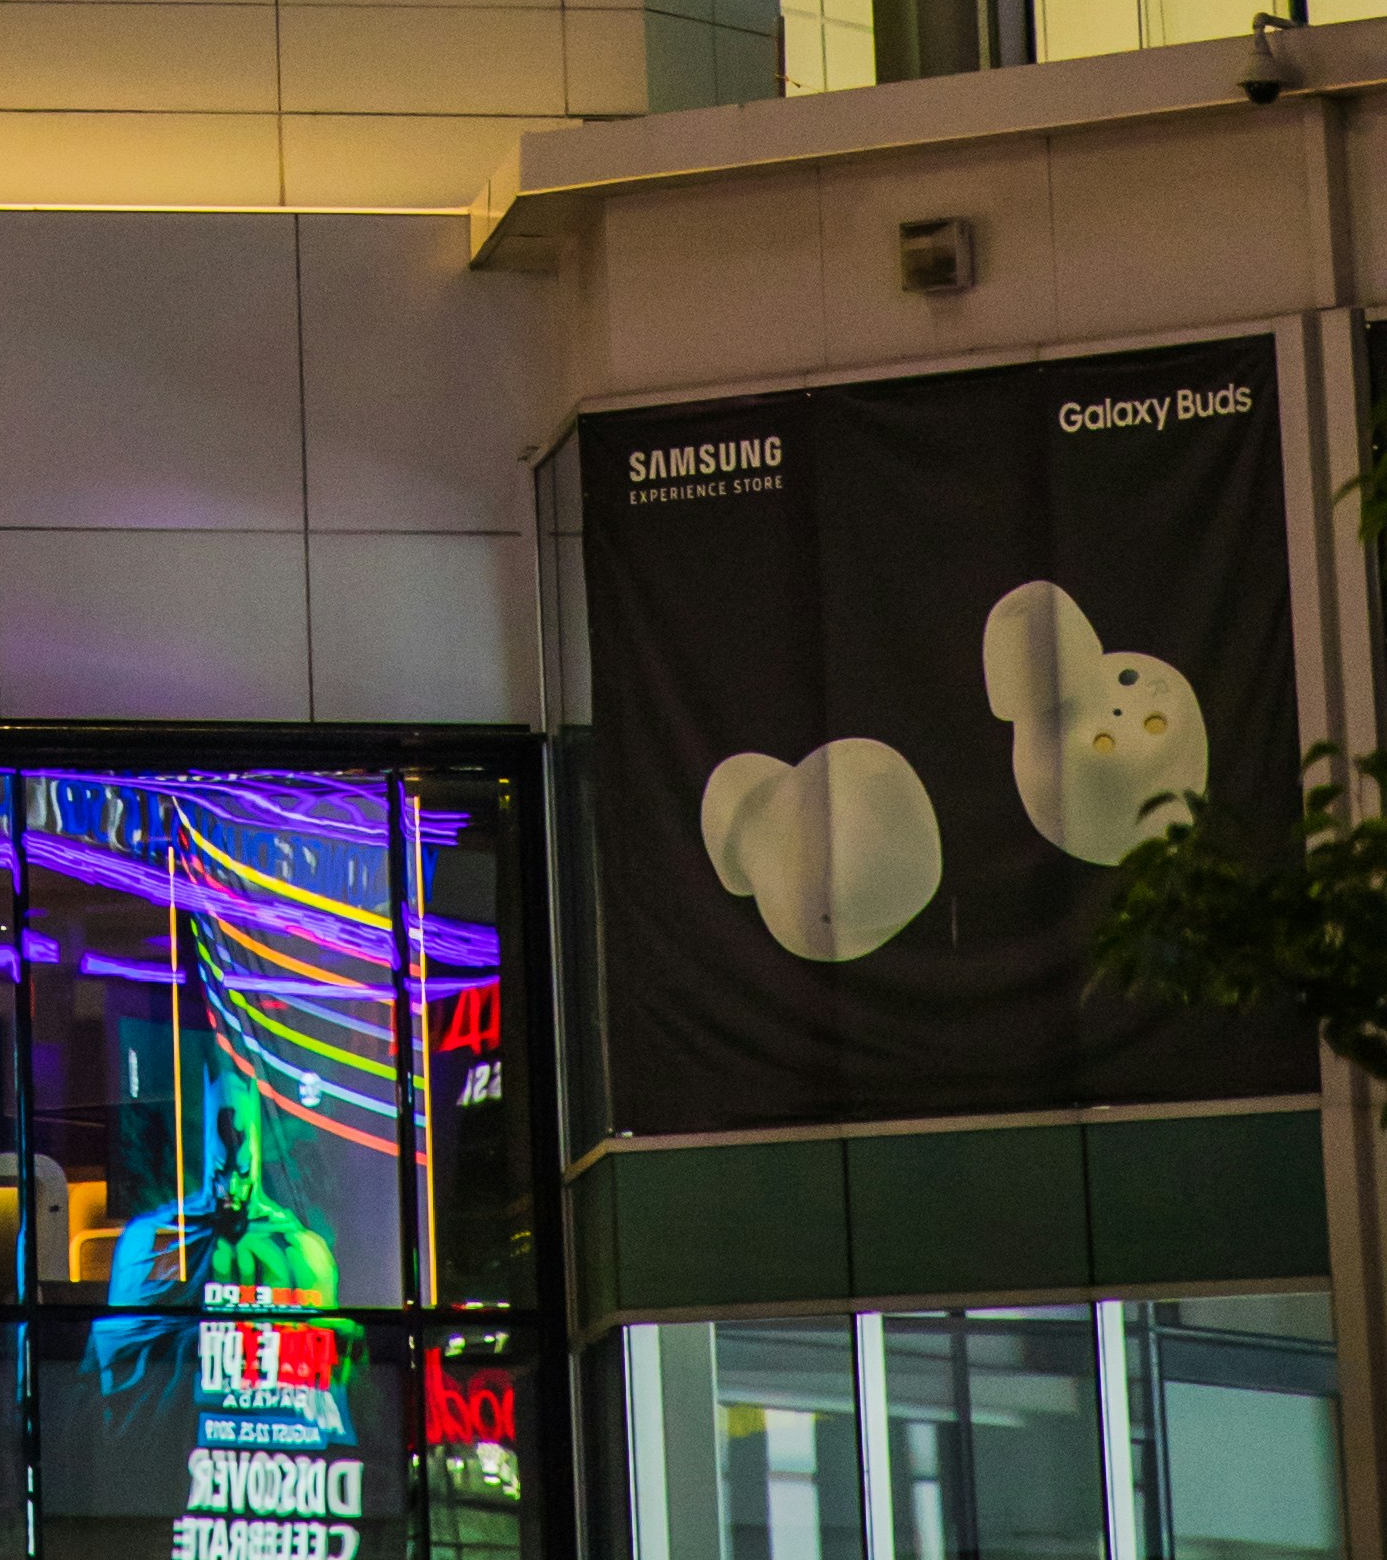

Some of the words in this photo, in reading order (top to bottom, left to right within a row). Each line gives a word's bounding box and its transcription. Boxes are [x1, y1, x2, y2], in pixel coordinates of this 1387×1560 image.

[1058, 394, 1170, 432] Galaxy
[1177, 383, 1253, 420] Buds
[629, 435, 783, 482] SAMSUNG
[629, 482, 728, 505] EXPERIENCE
[732, 474, 784, 494] STORE
